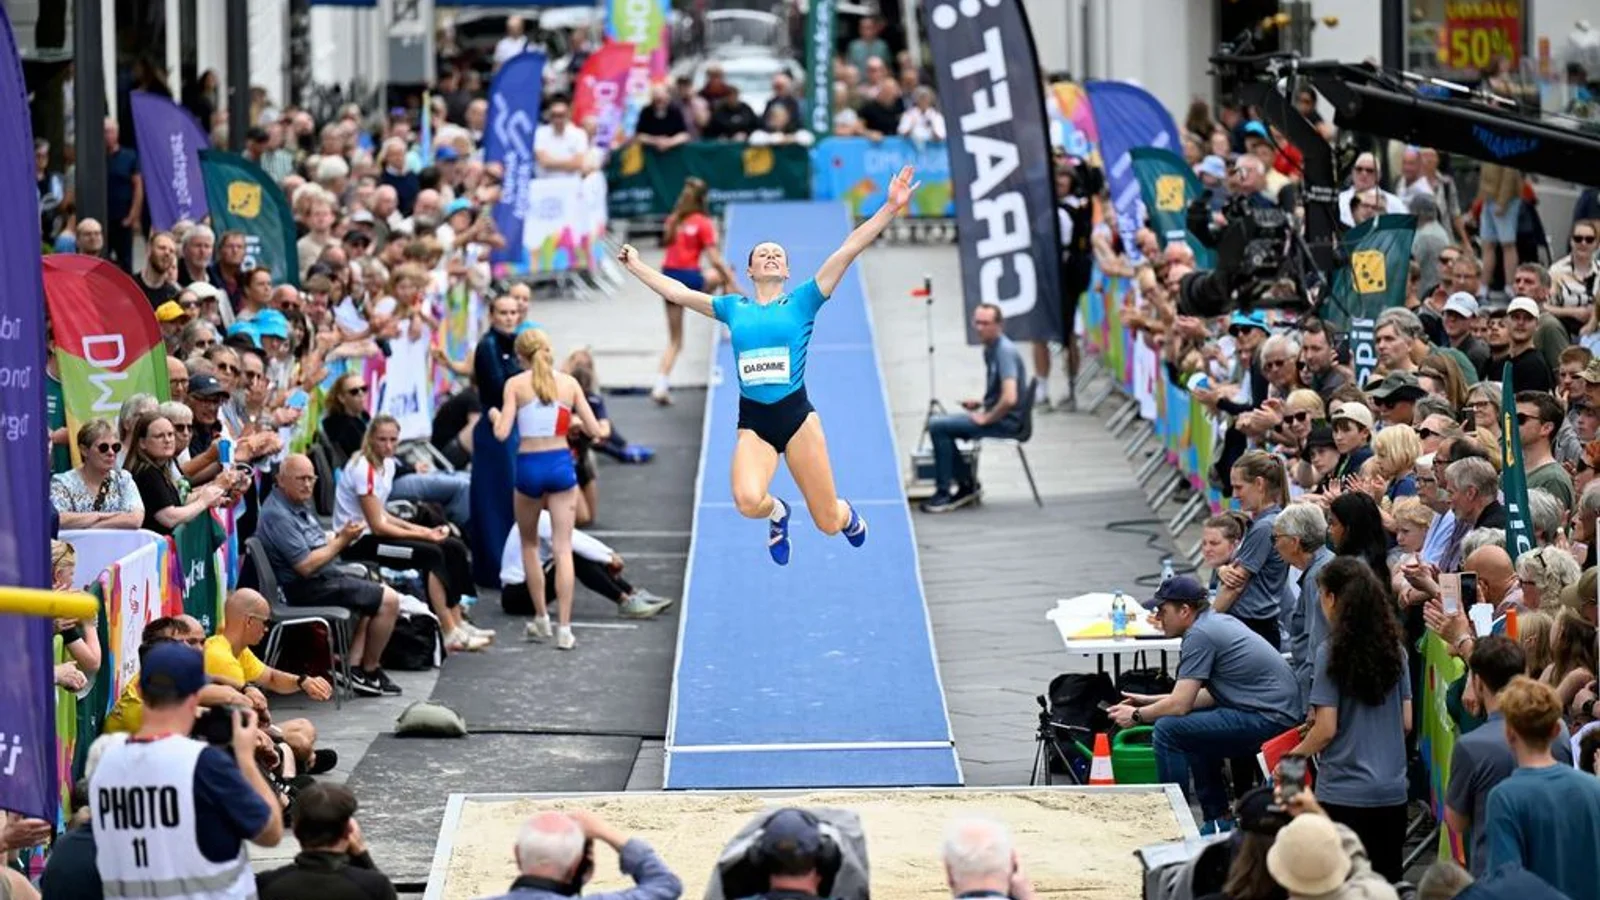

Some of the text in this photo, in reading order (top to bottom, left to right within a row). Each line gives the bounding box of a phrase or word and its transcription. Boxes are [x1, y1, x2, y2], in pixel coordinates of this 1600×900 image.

[1452, 27, 1514, 68] 50%
[82, 334, 129, 412] DM
[743, 361, 786, 374] IDA BOMME
[99, 785, 180, 829] PHOTO
[131, 836, 148, 867] 11
